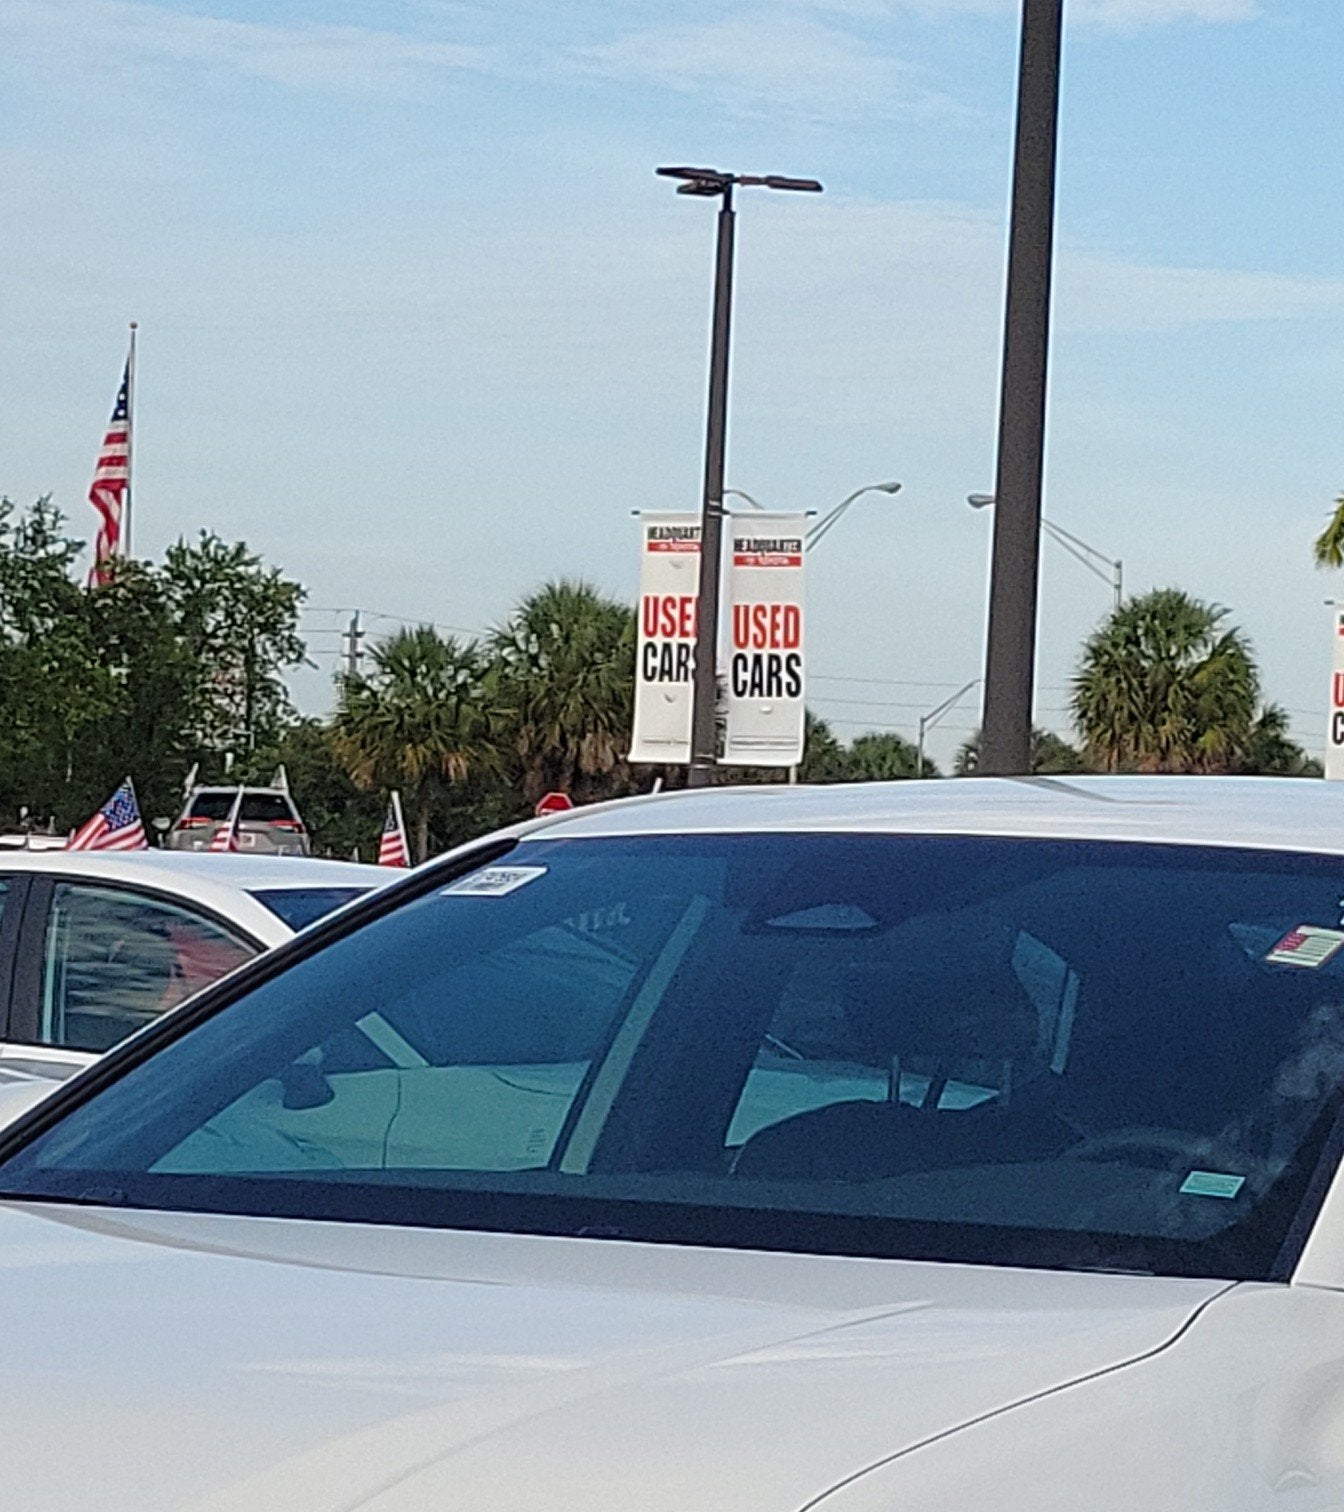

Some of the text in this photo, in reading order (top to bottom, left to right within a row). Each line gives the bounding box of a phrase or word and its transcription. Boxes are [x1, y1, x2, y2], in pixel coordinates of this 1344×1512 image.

[644, 596, 698, 638] USE
[733, 605, 800, 649] USED
[643, 642, 698, 682] CAR
[732, 653, 801, 698] CARS
